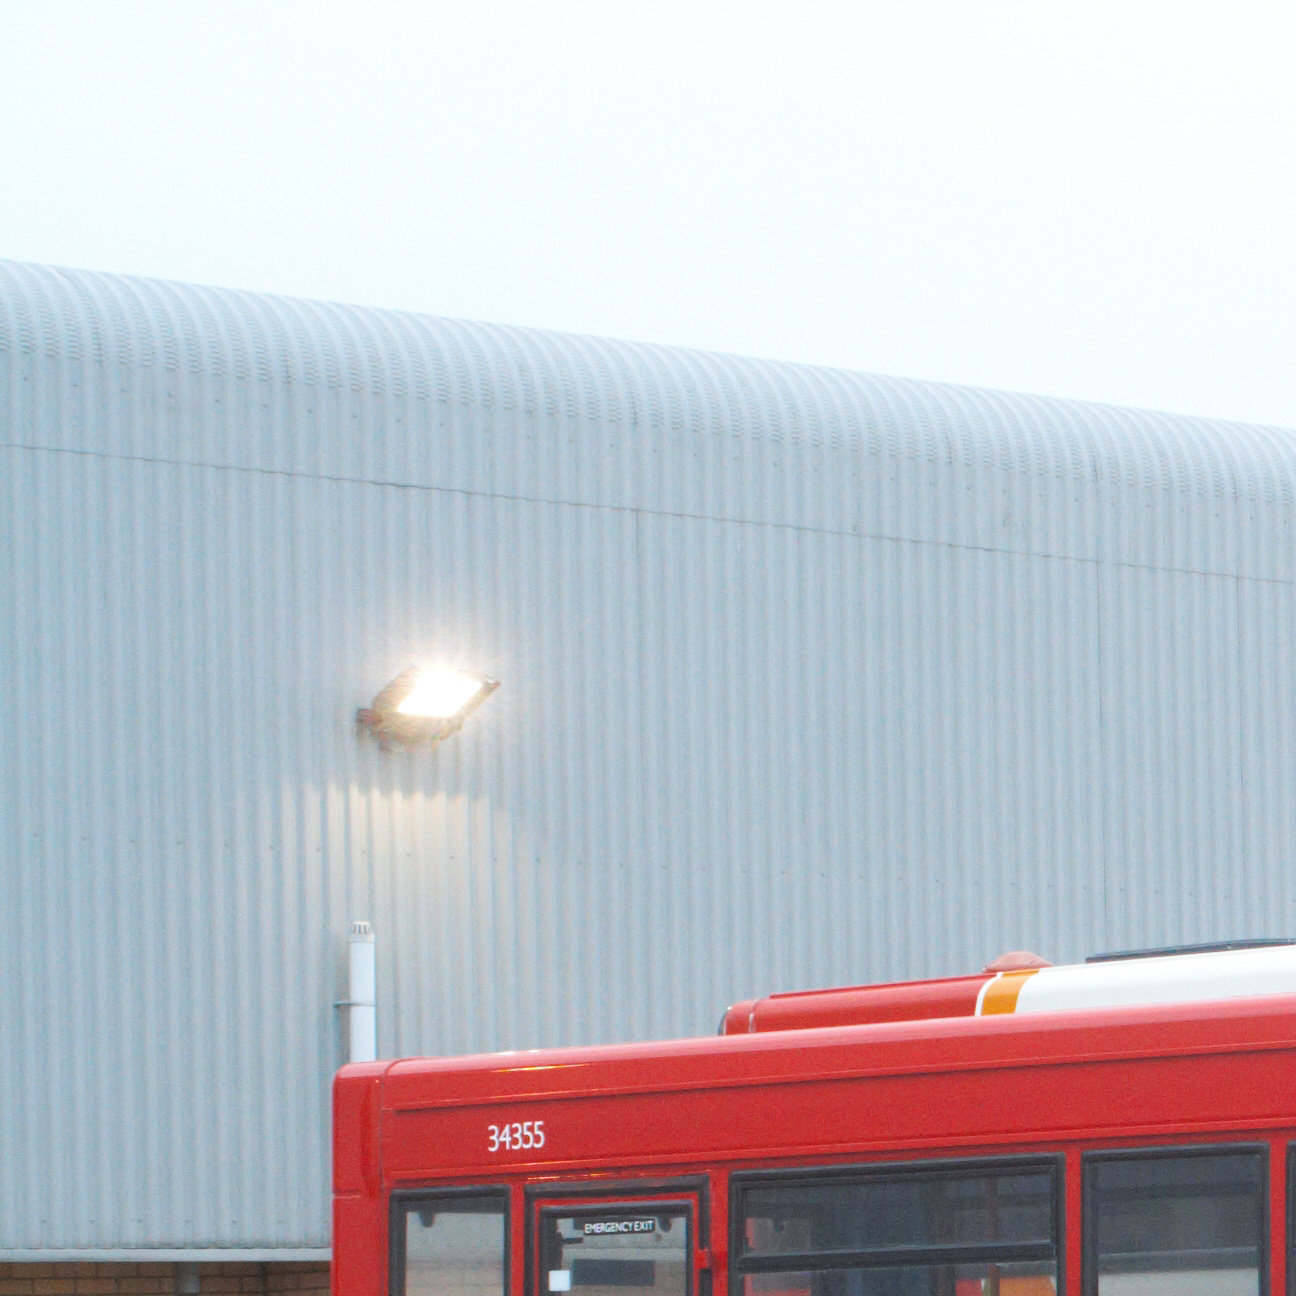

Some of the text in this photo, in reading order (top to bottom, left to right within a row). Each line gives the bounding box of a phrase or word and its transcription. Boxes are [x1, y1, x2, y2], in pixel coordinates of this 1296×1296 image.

[487, 1120, 545, 1152] 34355
[584, 1220, 654, 1234] EMERGENCY EXIT
